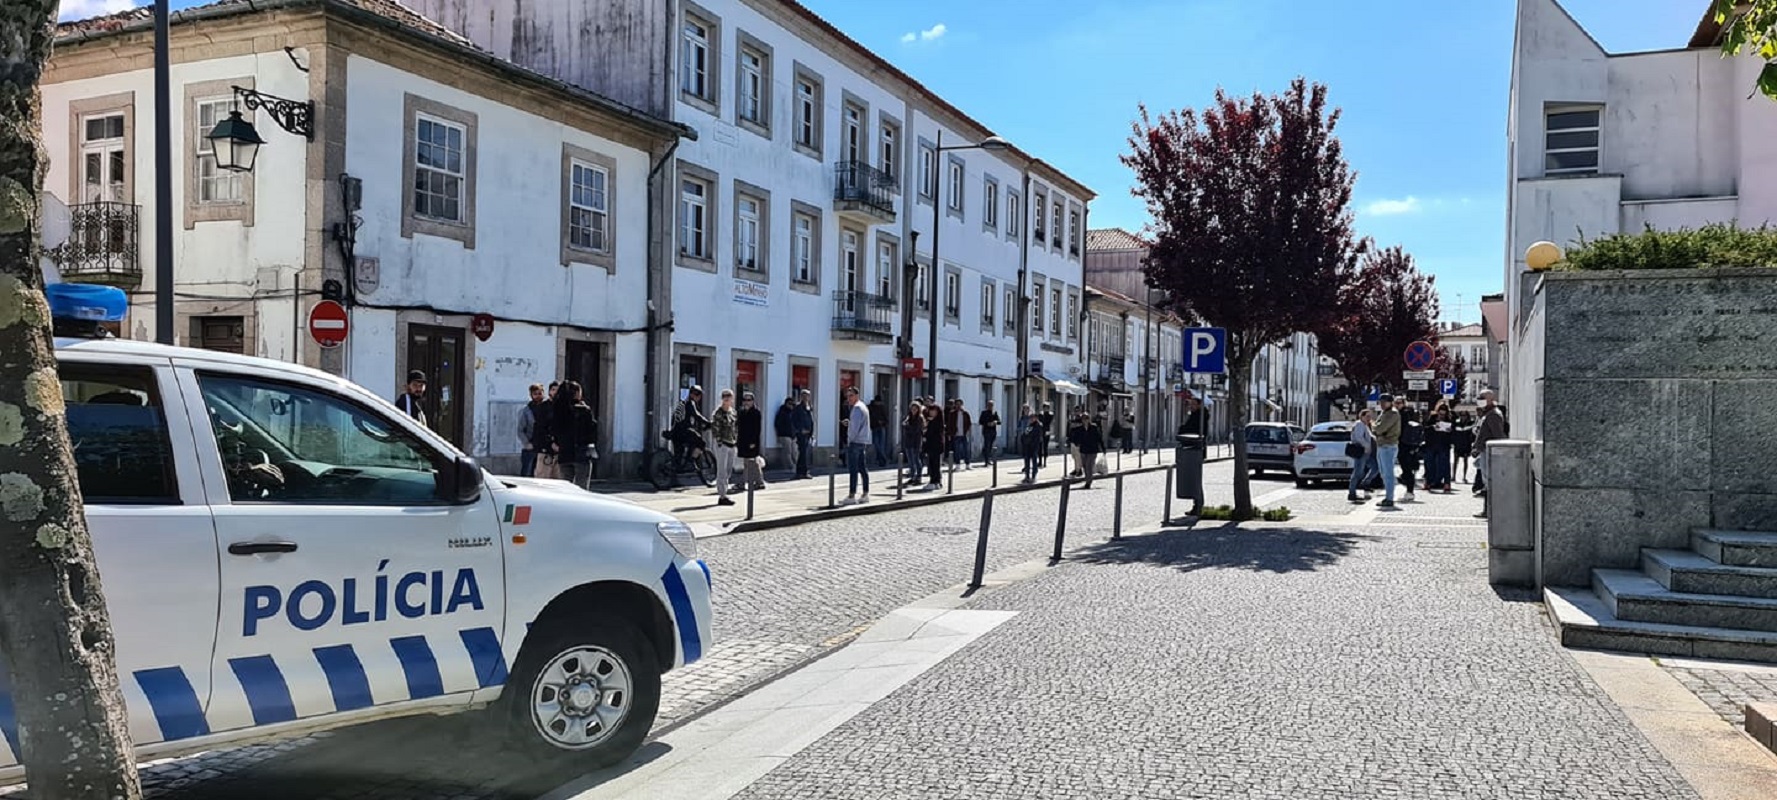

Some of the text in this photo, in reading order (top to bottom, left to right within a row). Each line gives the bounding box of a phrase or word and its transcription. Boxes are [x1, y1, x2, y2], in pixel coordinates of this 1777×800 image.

[1191, 331, 1217, 368] P
[1444, 380, 1453, 393] P
[243, 559, 484, 636] POLÍCIA
